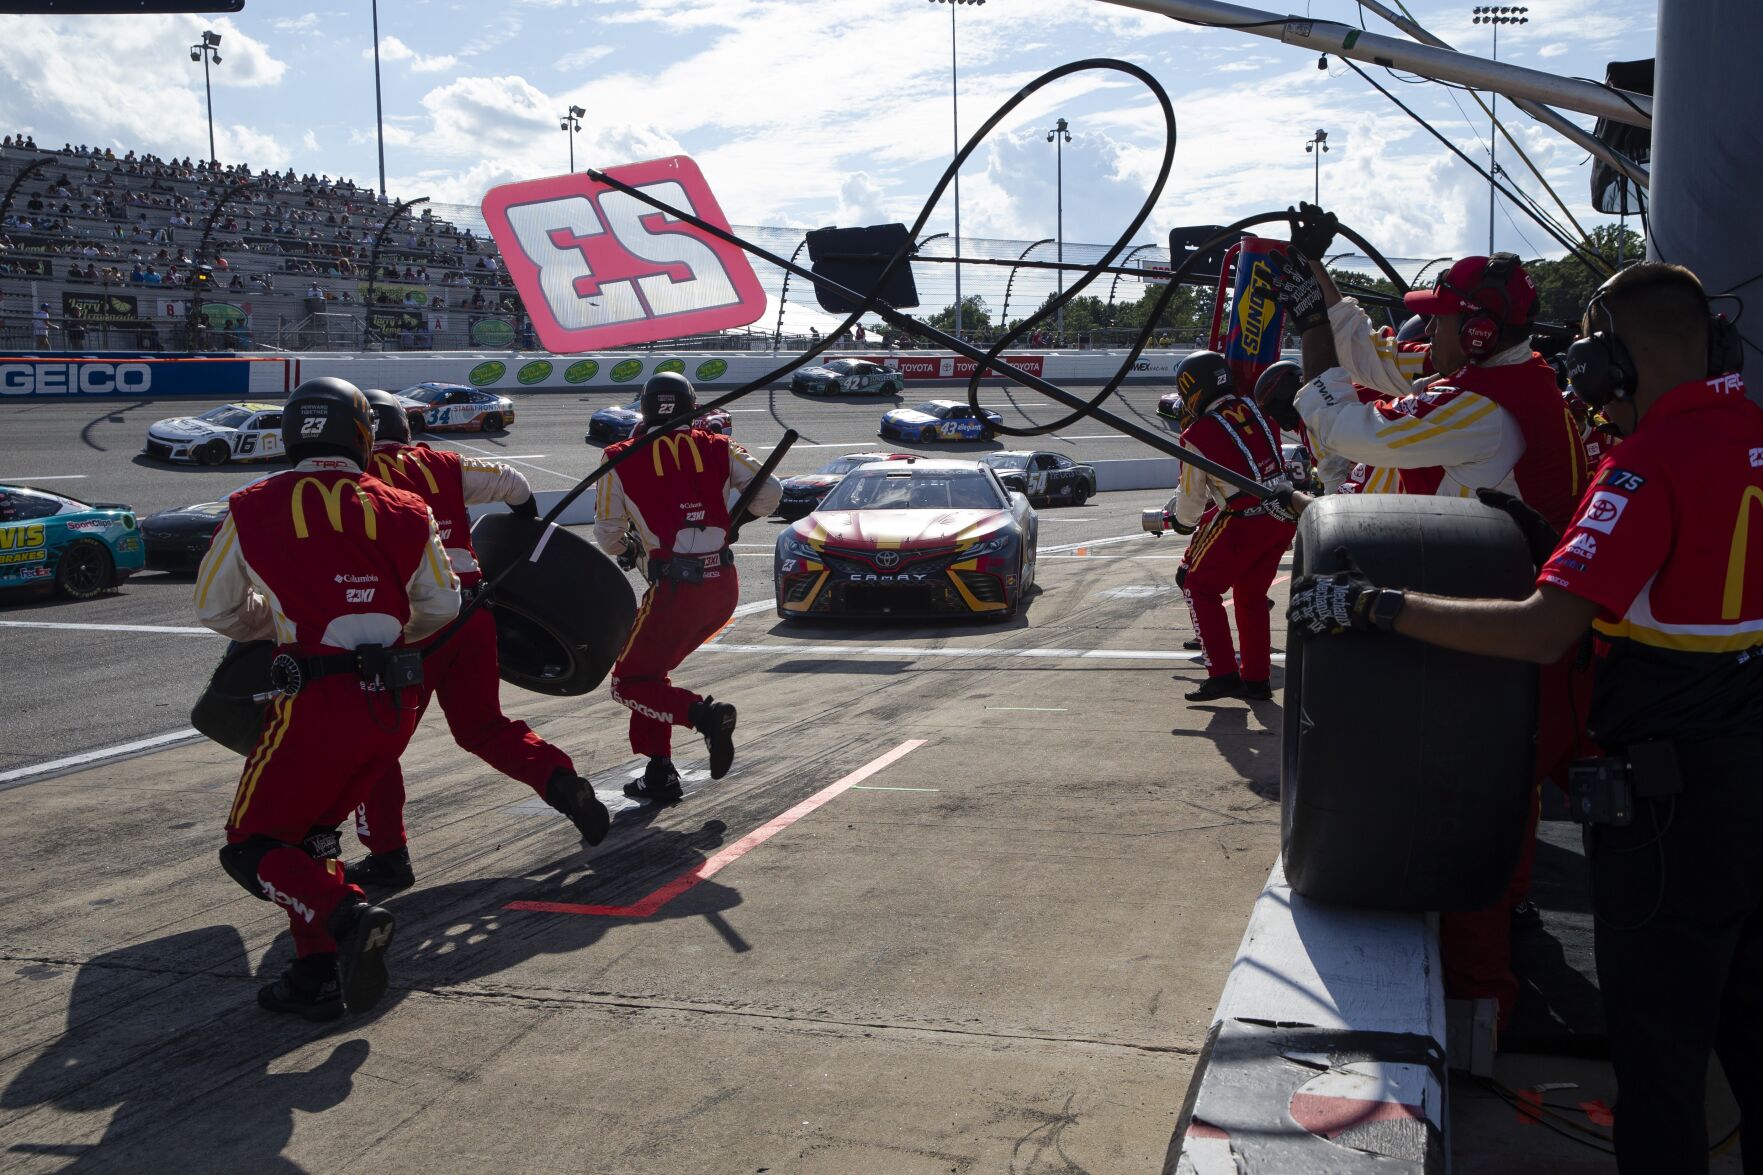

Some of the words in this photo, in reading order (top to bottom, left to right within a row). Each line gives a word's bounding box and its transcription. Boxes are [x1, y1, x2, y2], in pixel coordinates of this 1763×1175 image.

[166, 304, 175, 316] B
[435, 318, 442, 329] A
[1467, 327, 1492, 341] xfinity
[901, 363, 934, 372] TOYOTA
[0, 363, 152, 394] GEICO
[844, 375, 860, 389] 42
[1216, 375, 1228, 386] 23
[658, 403, 675, 414] 23
[427, 407, 450, 425] 34
[301, 417, 327, 434] 23
[941, 421, 958, 436] 43
[233, 431, 258, 454] 16
[312, 460, 348, 468] TRD
[1613, 471, 1644, 491] 75
[781, 559, 797, 572] 23
[343, 573, 379, 583] Columbia
[1333, 584, 1352, 628] Mechanix
